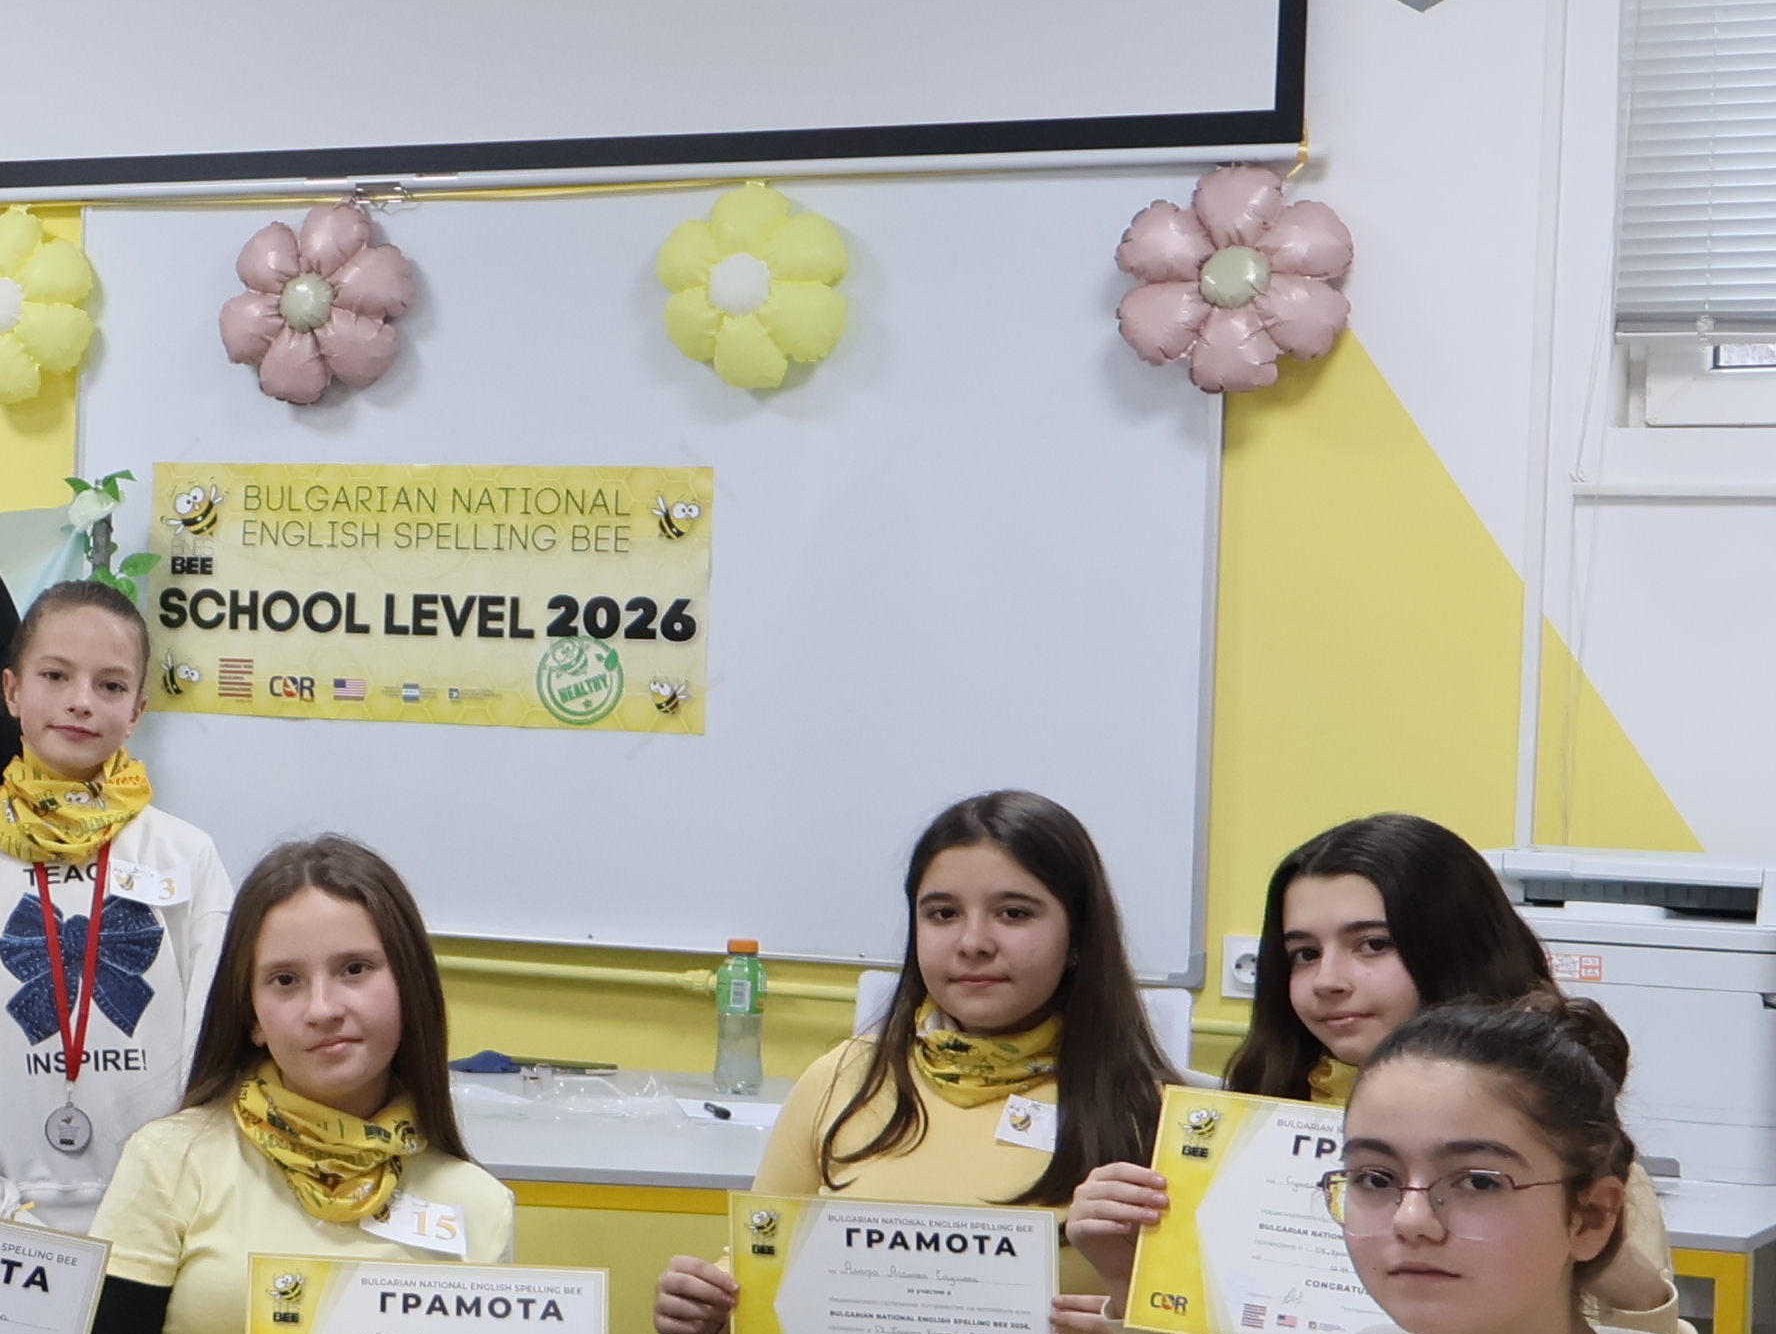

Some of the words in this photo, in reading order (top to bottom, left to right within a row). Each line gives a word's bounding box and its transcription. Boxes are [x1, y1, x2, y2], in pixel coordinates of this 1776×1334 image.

[243, 484, 437, 515] BULGARIAN
[451, 486, 630, 517] NATIONAL
[241, 520, 381, 549] ENGLISH
[393, 522, 556, 553] SPELLING
[570, 524, 630, 554] BEE
[170, 556, 214, 575] BEE
[159, 587, 371, 634] SCHOOL
[384, 592, 535, 639] LEVEL
[546, 594, 697, 642] 2026
[558, 677, 608, 704] HEALTHY
[23, 862, 100, 886] TEAC
[157, 877, 176, 901] 3
[26, 1049, 148, 1075] INSPIRE!
[1277, 1119, 1334, 1133] BULGARIAN
[1182, 1144, 1209, 1159] BEE
[412, 1210, 458, 1240] 15
[846, 1227, 1017, 1256] ГРАМОТА
[0, 1243, 54, 1262] SPELLING
[56, 1255, 79, 1267] BEE
[361, 1277, 416, 1287] BULGARIAN
[419, 1280, 467, 1289] NATIONAL
[470, 1283, 511, 1291] ENGLISH
[514, 1285, 560, 1294] SPELLING
[564, 1287, 582, 1295] BEE
[273, 1312, 299, 1323] BEE
[379, 1291, 564, 1321] ГРАМОТА
